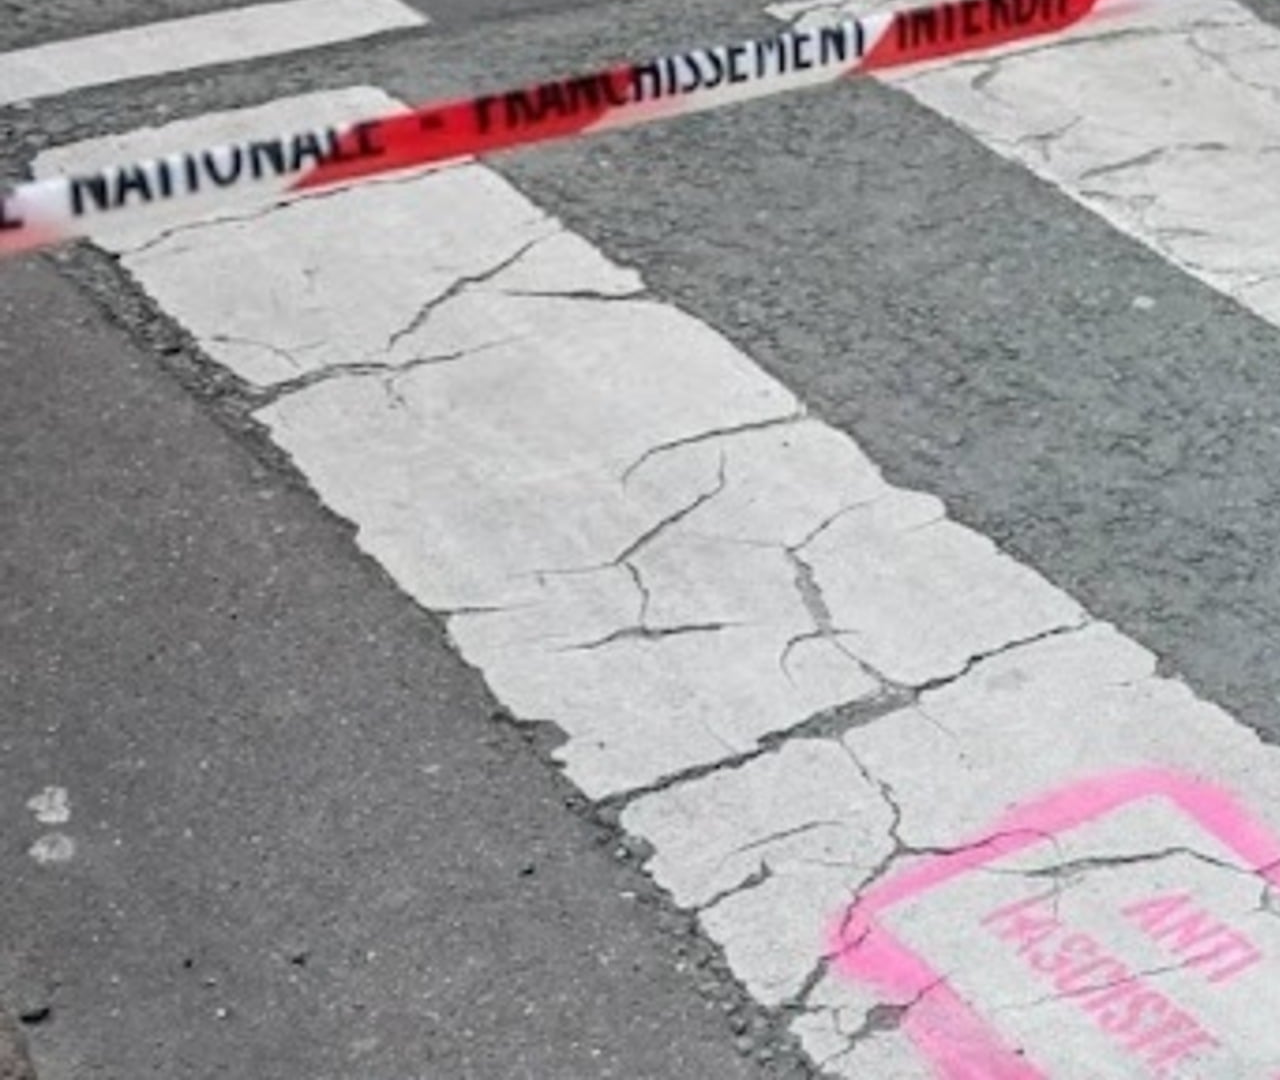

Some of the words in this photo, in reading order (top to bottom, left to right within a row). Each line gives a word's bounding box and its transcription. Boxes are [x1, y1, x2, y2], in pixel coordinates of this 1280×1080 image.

[71, 121, 385, 214] NATIONALE
[474, 20, 865, 134] FRANCHISSEMENT
[1119, 892, 1262, 984] ANTI
